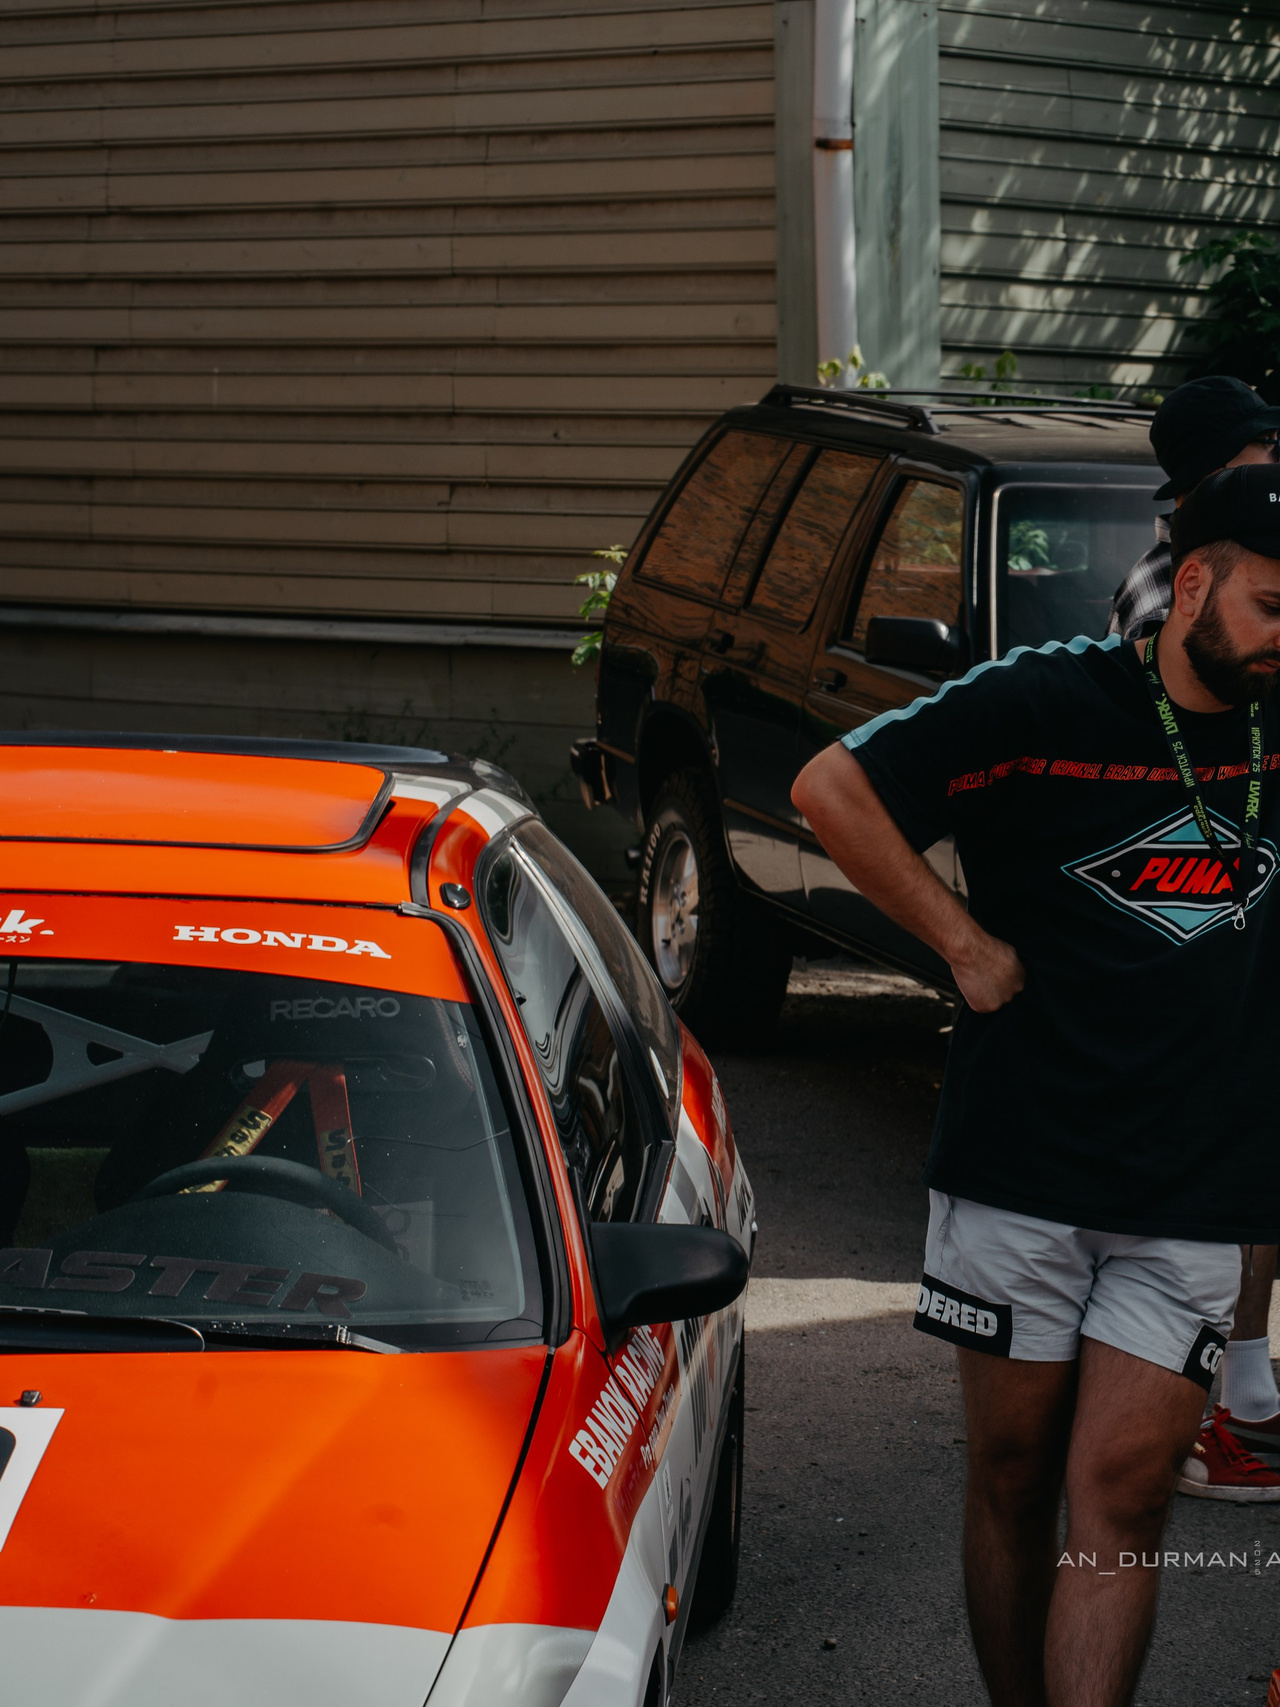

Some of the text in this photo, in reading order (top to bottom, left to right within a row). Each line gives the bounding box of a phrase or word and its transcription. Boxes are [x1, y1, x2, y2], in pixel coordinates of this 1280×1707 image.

[1049, 759, 1102, 780] ORIGINAL
[1103, 764, 1148, 781] BRAND
[173, 925, 393, 959] HONDA
[270, 996, 401, 1022] RECARO
[568, 1325, 665, 1490] EBANOK RACING
